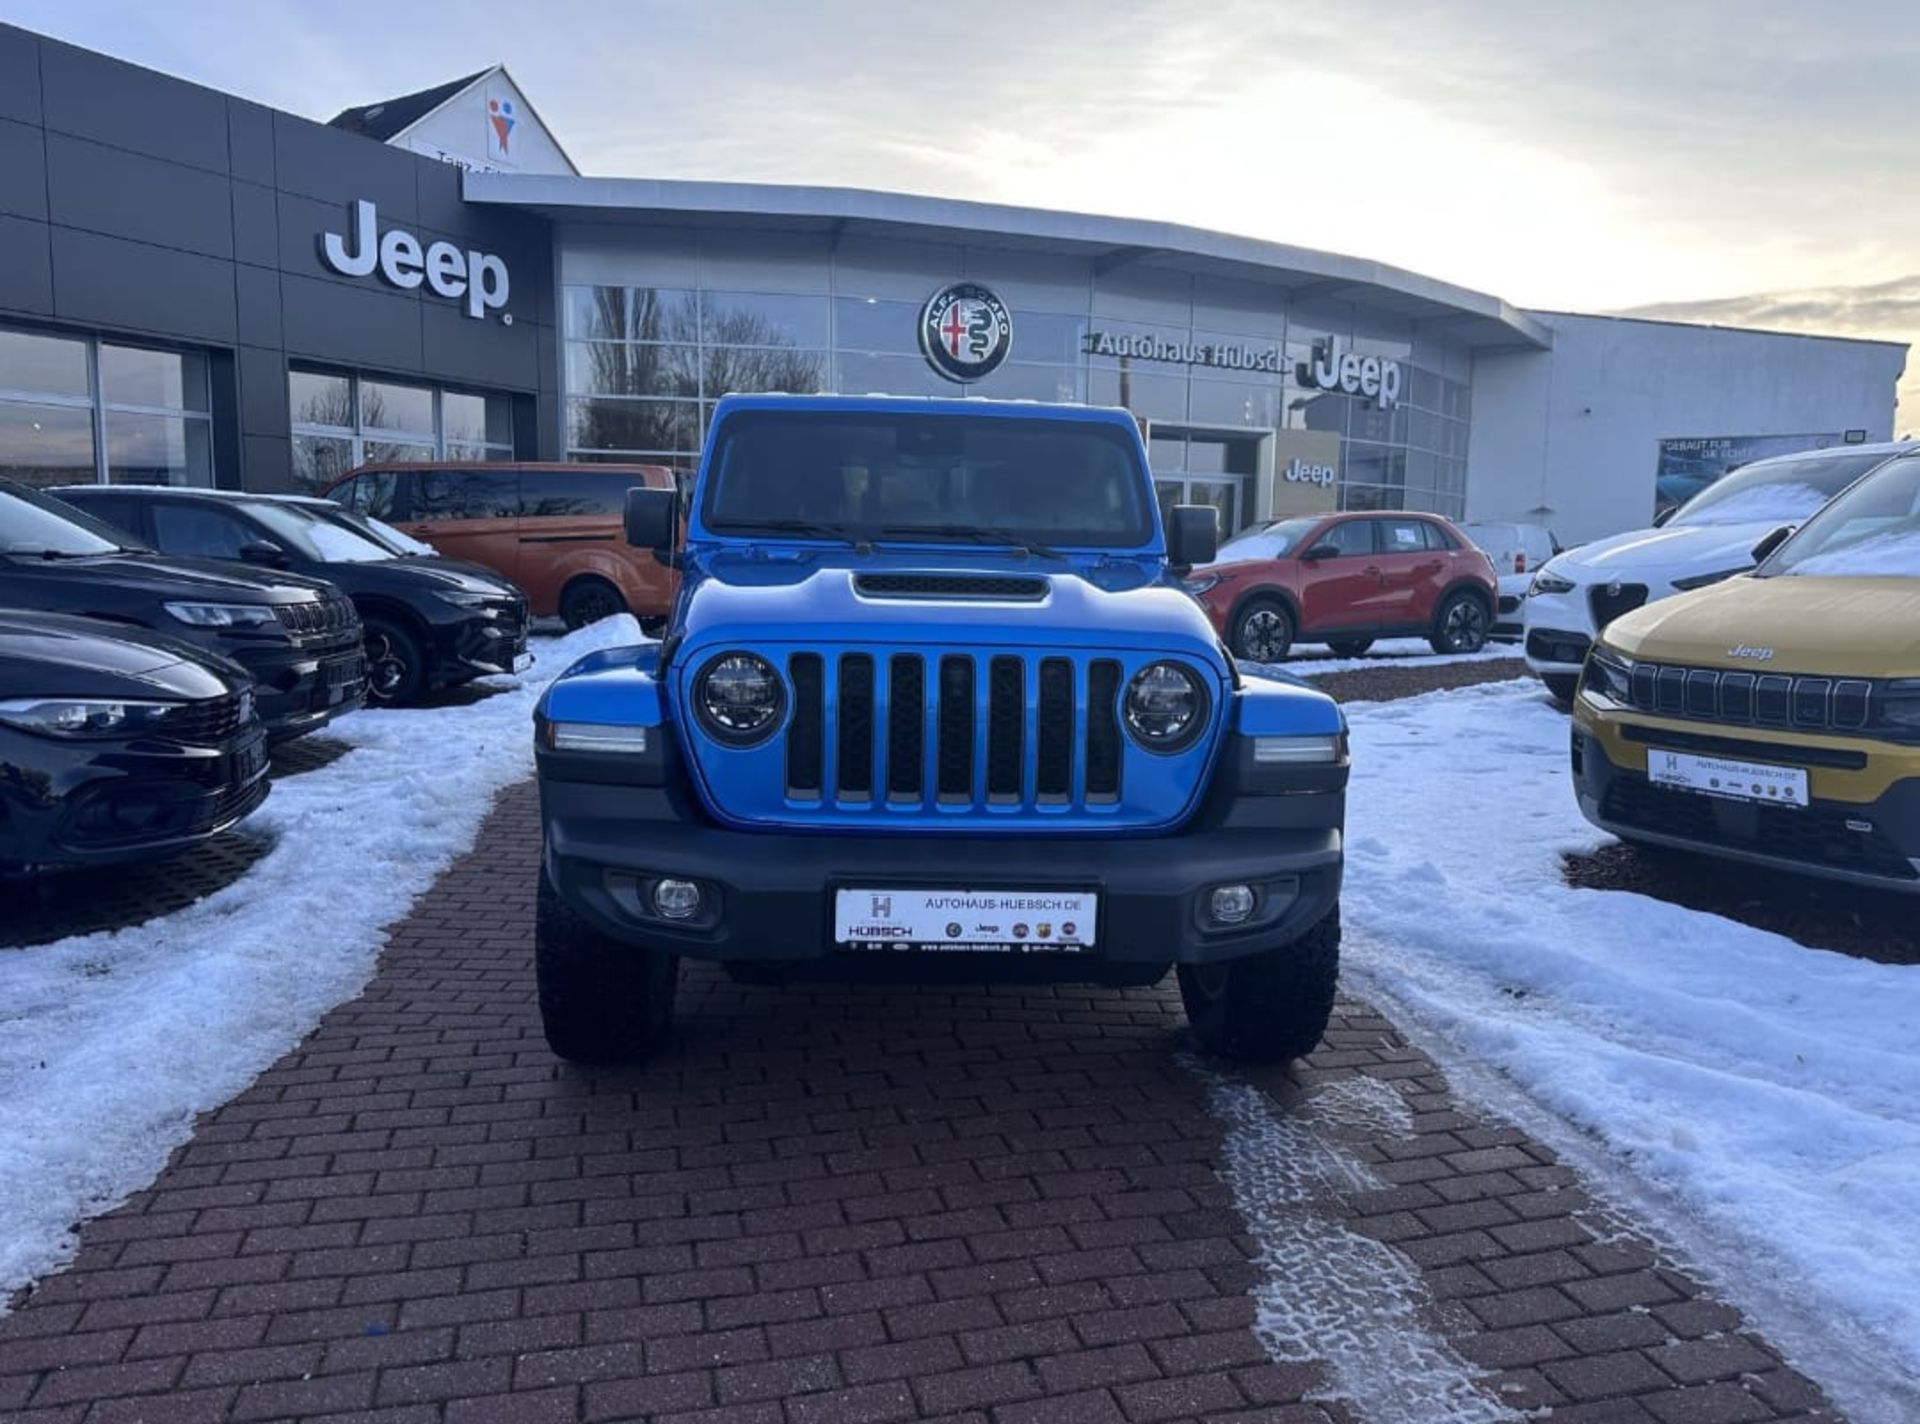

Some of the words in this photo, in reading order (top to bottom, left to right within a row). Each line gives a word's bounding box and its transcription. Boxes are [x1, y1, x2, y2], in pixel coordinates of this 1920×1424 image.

[325, 199, 510, 319] Jeep
[929, 292, 956, 330] ALFA
[1099, 332, 1206, 363] Autohaus
[1315, 334, 1400, 409] Jeep
[1286, 458, 1334, 487] Jeep
[1728, 640, 1773, 660] Jeep
[926, 898, 1081, 911] AUTOHAUS-HUEBSCH.DE
